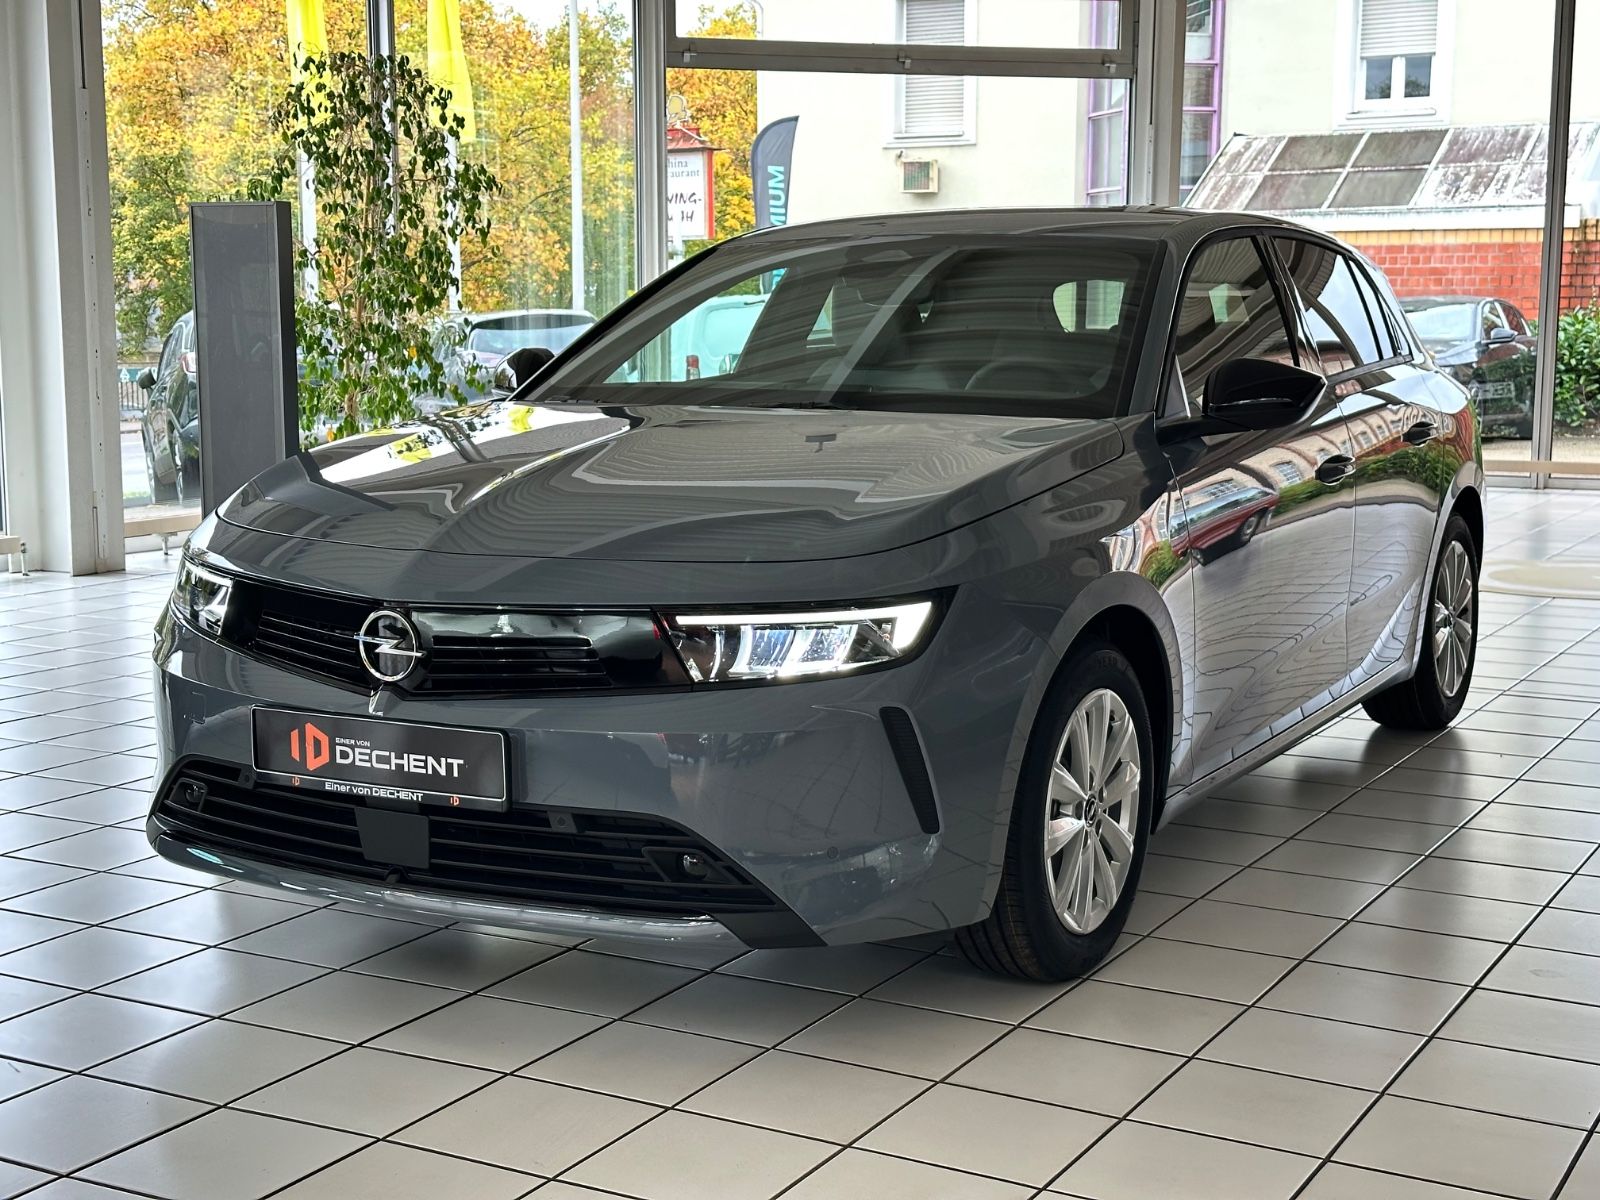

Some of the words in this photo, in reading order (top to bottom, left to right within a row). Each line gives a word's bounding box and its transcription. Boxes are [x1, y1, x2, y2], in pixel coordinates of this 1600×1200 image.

[667, 158, 688, 168] hina
[335, 737, 355, 746] EINER
[335, 745, 464, 778] DECHENT
[325, 782, 350, 792] Einer
[352, 786, 371, 795] von
[372, 787, 423, 801] DECHENT
